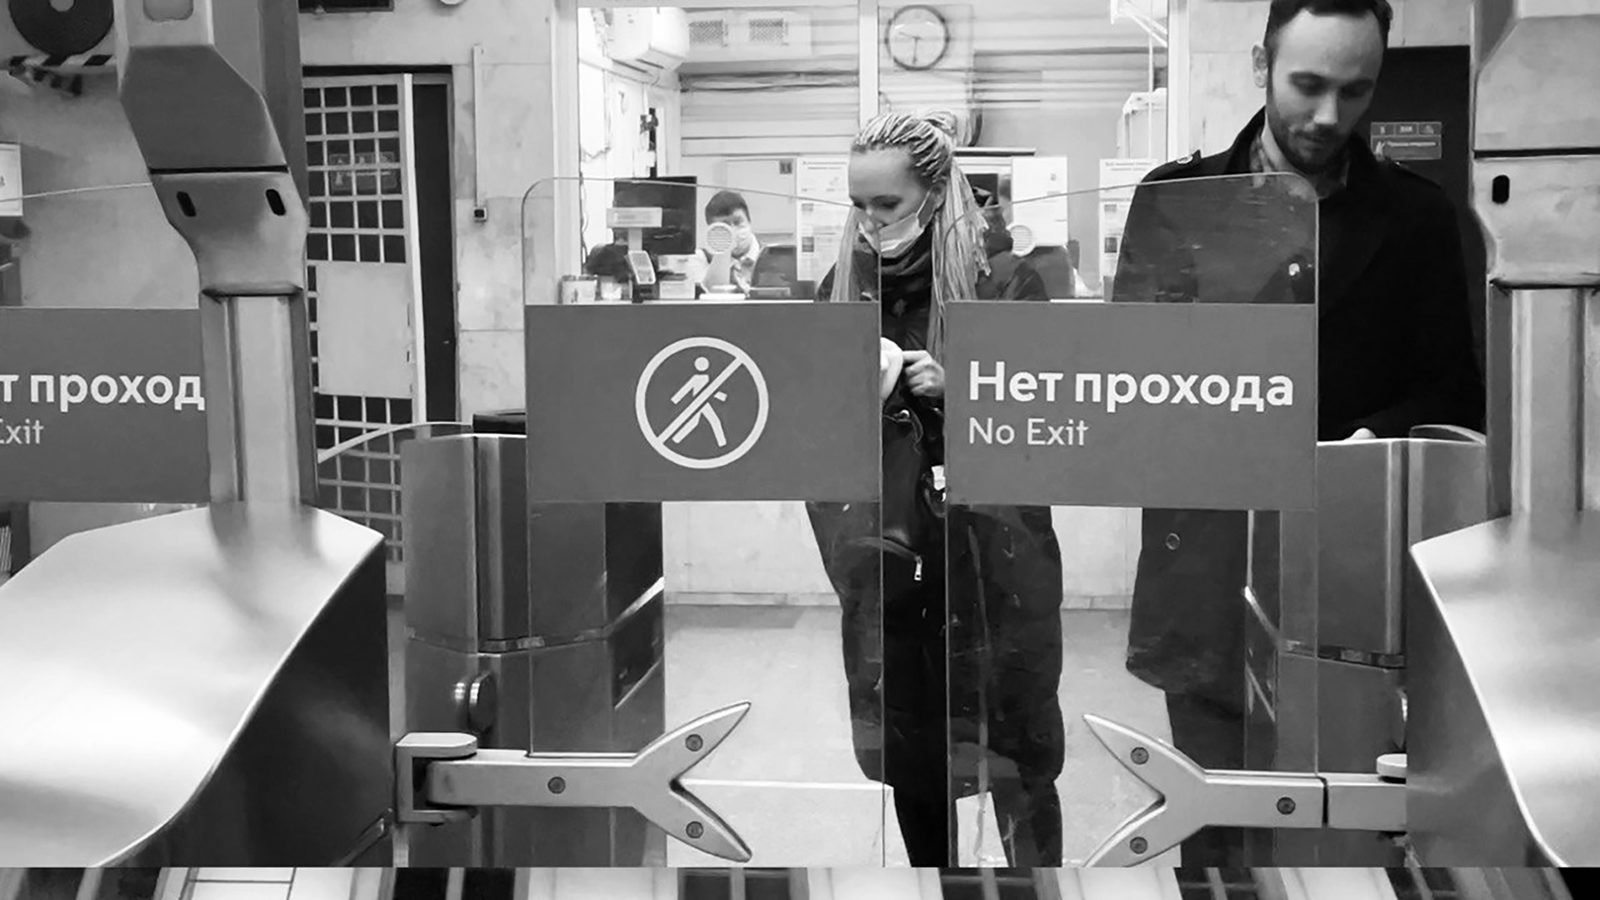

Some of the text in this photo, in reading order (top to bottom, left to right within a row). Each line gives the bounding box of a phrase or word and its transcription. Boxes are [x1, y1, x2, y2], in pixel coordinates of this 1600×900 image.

[968, 360, 1294, 413] Нет прохода
[0, 418, 45, 444] xit
[968, 416, 1090, 446] No Exit
